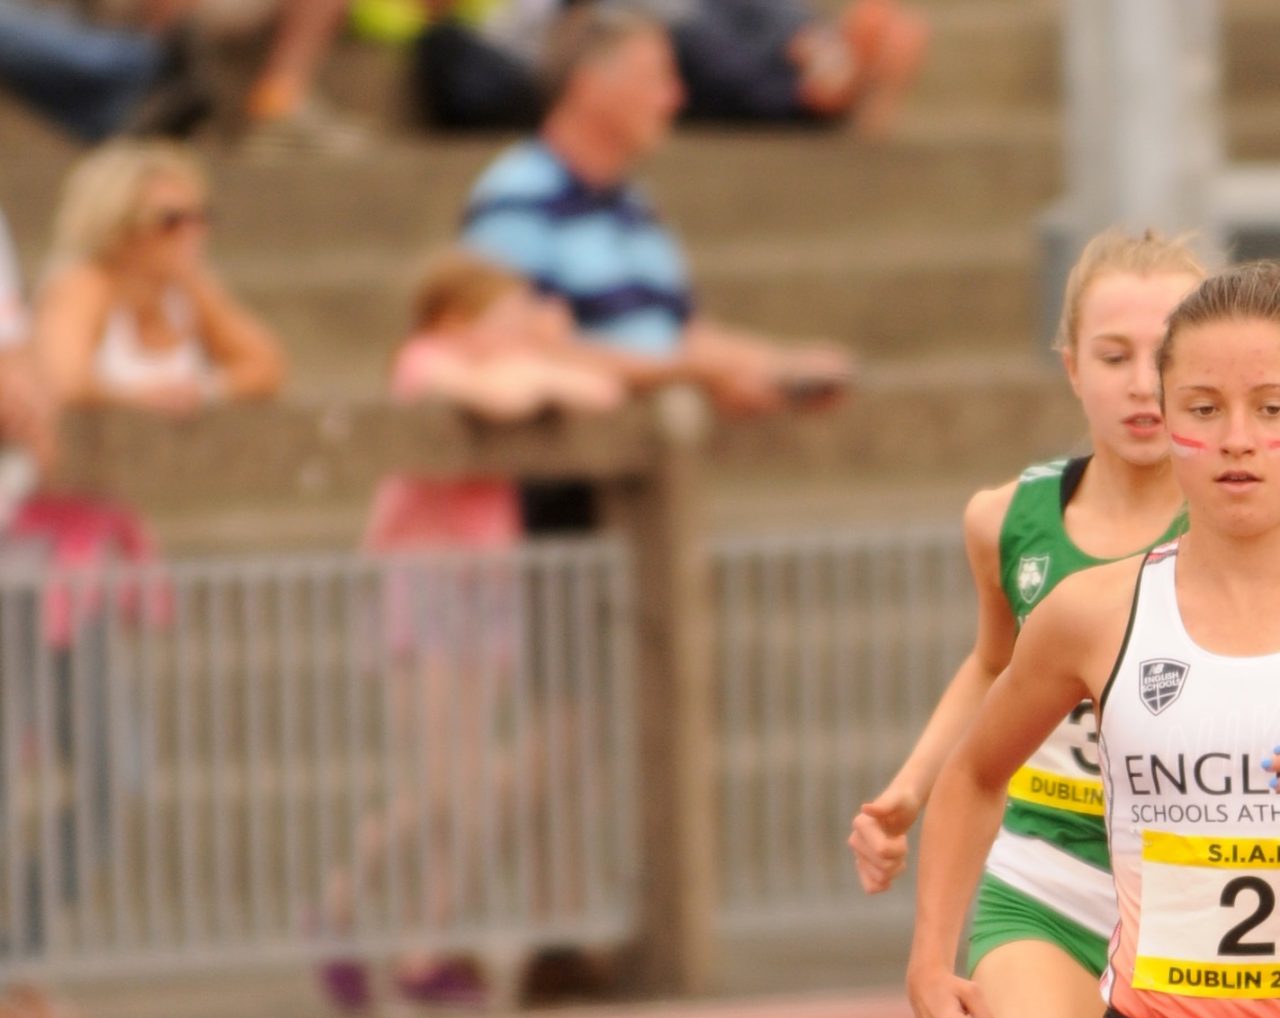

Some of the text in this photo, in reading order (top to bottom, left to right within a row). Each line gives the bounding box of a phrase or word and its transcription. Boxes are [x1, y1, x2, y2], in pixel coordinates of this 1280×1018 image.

[1031, 776, 1104, 806] DUBLIN
[1131, 804, 1229, 823] SCHOOLS
[1217, 875, 1276, 956] 2
[1168, 966, 1262, 989] DUBLIN
